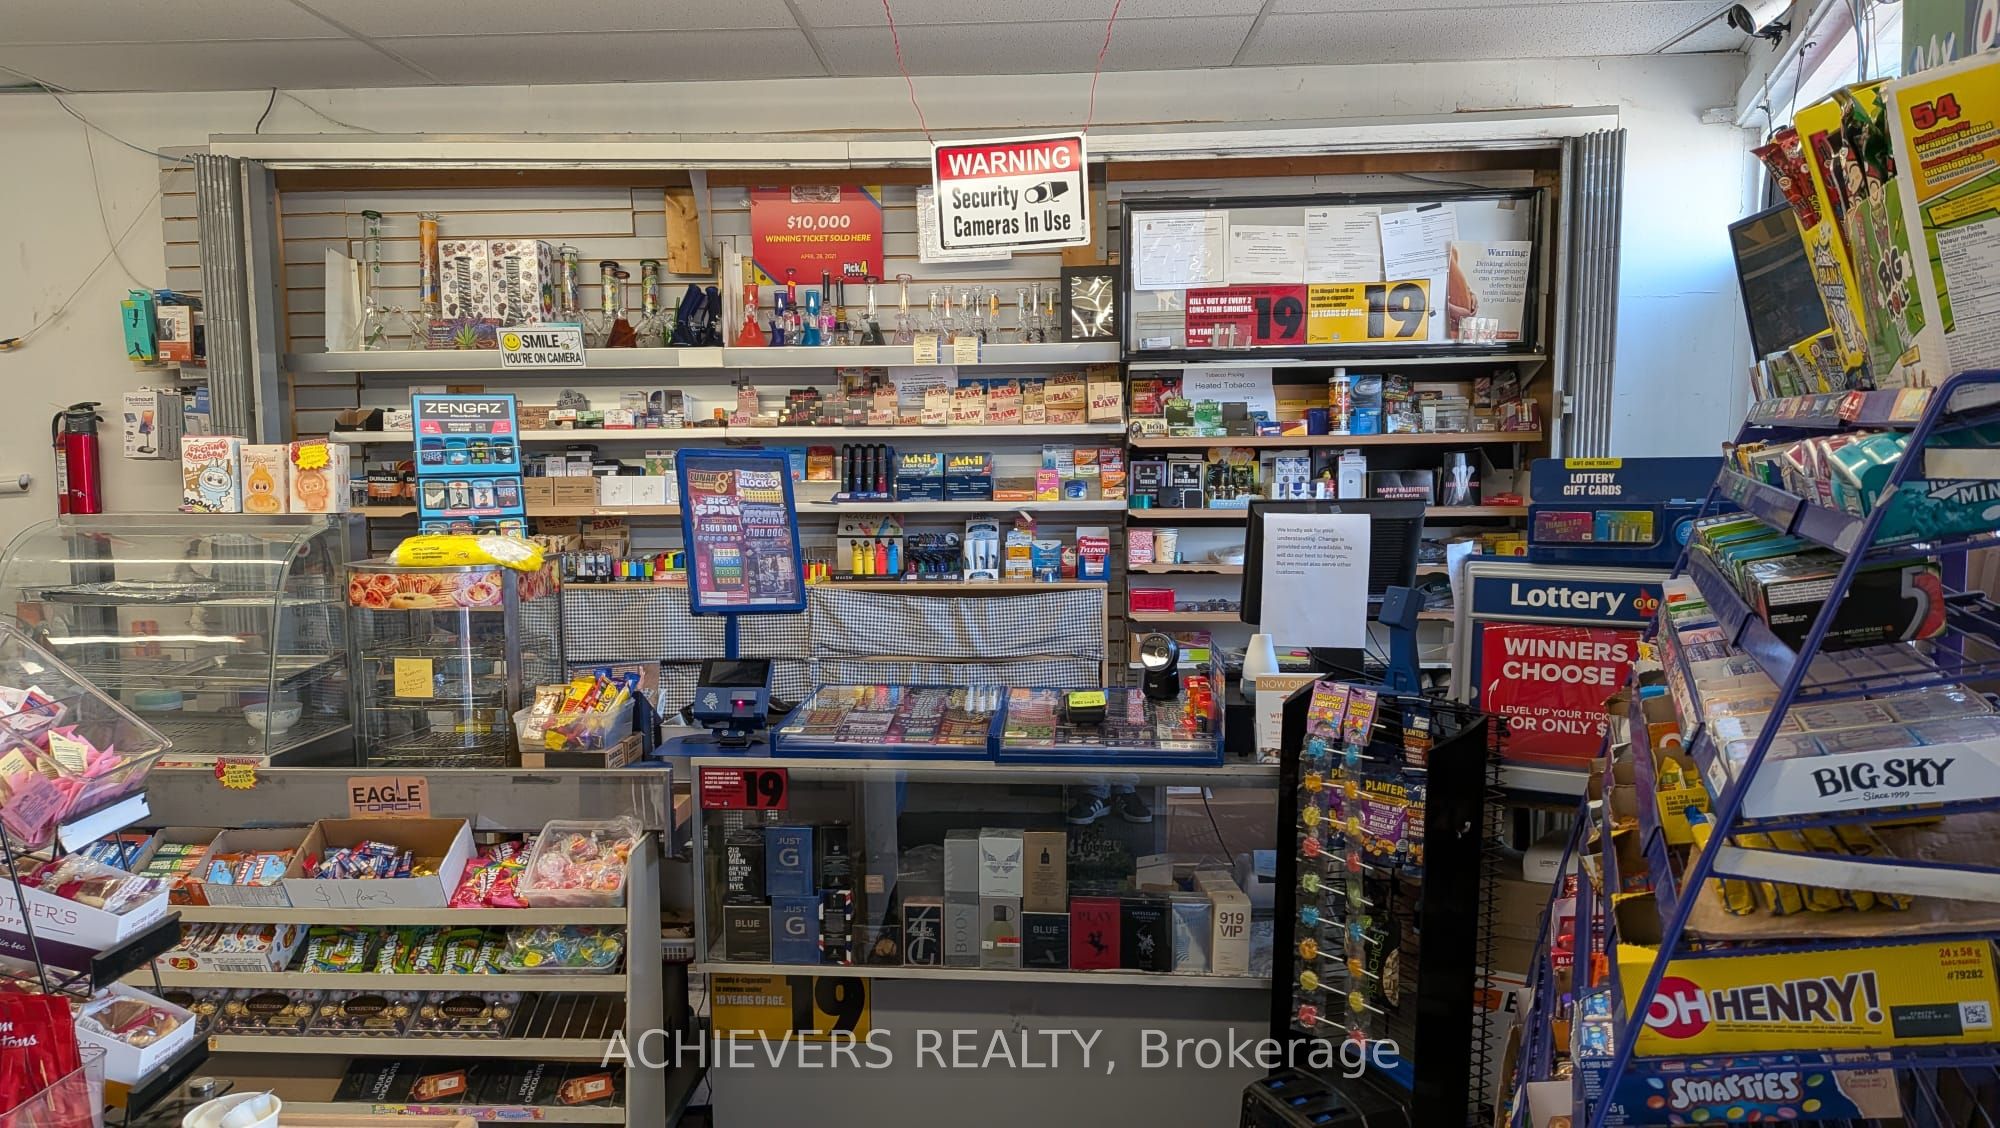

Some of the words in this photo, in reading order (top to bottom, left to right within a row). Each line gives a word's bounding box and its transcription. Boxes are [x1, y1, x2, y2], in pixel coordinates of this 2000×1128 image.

[1910, 93, 1961, 130] 54
[1915, 134, 1958, 153] Wrapped
[1959, 121, 1993, 139] Grilled
[1919, 143, 1957, 160] Seaweed
[1958, 137, 1975, 148] Roll
[948, 146, 1071, 176] WARNING
[952, 185, 1019, 210] Security
[787, 215, 851, 231] $10,000
[953, 215, 1019, 238] Cameras
[1024, 211, 1039, 233] In
[1043, 209, 1071, 232] Use
[1937, 228, 1966, 239] Nutrition
[1967, 223, 1984, 233] Facts
[830, 234, 850, 242] SOLD
[851, 234, 871, 242] HERE
[1940, 237, 1959, 246] Valeur
[1960, 230, 1988, 241] nutritive
[1488, 249, 1529, 257] Warning:
[1877, 247, 1903, 296] BIG
[1228, 297, 1246, 305] EVERY
[1886, 284, 1911, 321] ROLL
[1319, 309, 1340, 318] YEARS
[1341, 309, 1349, 317] OF
[1365, 283, 1426, 339] 19
[1255, 296, 1303, 339] 19
[521, 334, 560, 348] SMILE
[505, 352, 533, 364] YOU'RE
[534, 352, 546, 363] ON
[547, 352, 581, 363] CAMERA
[927, 389, 947, 397] RAW
[955, 390, 981, 400] RAW
[991, 388, 1017, 399] RAW
[425, 403, 502, 414] ZENGAZ
[1092, 398, 1119, 409] RAW
[926, 412, 943, 420] RAW
[955, 410, 981, 421] RAW
[991, 409, 1017, 421] RAW
[1053, 410, 1079, 423] RAW
[902, 453, 930, 465] Advil
[954, 456, 983, 466] Advil
[690, 472, 717, 483] LUNAR
[1570, 473, 1615, 484] LOTTERY
[1563, 485, 1587, 495] GIFT
[1588, 485, 1622, 496] CARDS
[706, 496, 728, 505] BIG
[743, 509, 786, 518] MONEY
[742, 517, 785, 525] MACHINE
[1510, 583, 1627, 616] Lottery
[1901, 566, 1930, 641] 5
[1503, 637, 1629, 663] WINNERS
[1502, 661, 1617, 686] CHOOSE
[1261, 680, 1286, 689] NOW
[1500, 705, 1532, 716] LEVEL
[1534, 707, 1550, 717] UP
[1552, 708, 1581, 720] YOUR
[1584, 711, 1610, 722] TICK
[1542, 720, 1592, 736] ONLY
[1811, 764, 1879, 798] BIG
[1883, 758, 1955, 788] SKY
[352, 779, 420, 804] EAGLE
[743, 771, 785, 807] 19
[1863, 791, 1890, 801] Since
[1890, 790, 1910, 799] 1999
[354, 803, 422, 813] TORCH
[776, 837, 801, 845] JUST
[779, 849, 800, 867] G
[729, 883, 744, 891] NYC
[783, 905, 808, 913] JUST
[1078, 911, 1113, 922] PLAY
[1219, 912, 1245, 926] 919
[735, 919, 761, 928] BLUE
[785, 917, 806, 935] G
[1033, 925, 1059, 935] BLUE
[1220, 925, 1244, 938] VIP
[1939, 948, 1952, 958] 24
[1960, 947, 1974, 957] 58
[1975, 949, 1981, 958] g
[1947, 969, 1984, 980] #79282
[716, 995, 726, 1005] 19
[727, 995, 754, 1006] YEARS
[755, 996, 766, 1006] OF
[767, 996, 785, 1006] AGE.
[1644, 990, 1711, 1029] OH
[1712, 970, 1885, 1024] HENRY!
[347, 1004, 387, 1012] COLLECTION
[445, 1004, 483, 1013] COLLECTION
[786, 975, 866, 1037] 19
[1581, 1049, 1594, 1057] 24
[378, 1062, 401, 1101] CHOCOLATES
[525, 1063, 545, 1103] CHOCOLATES
[1671, 1072, 1798, 1109] SMARTIES
